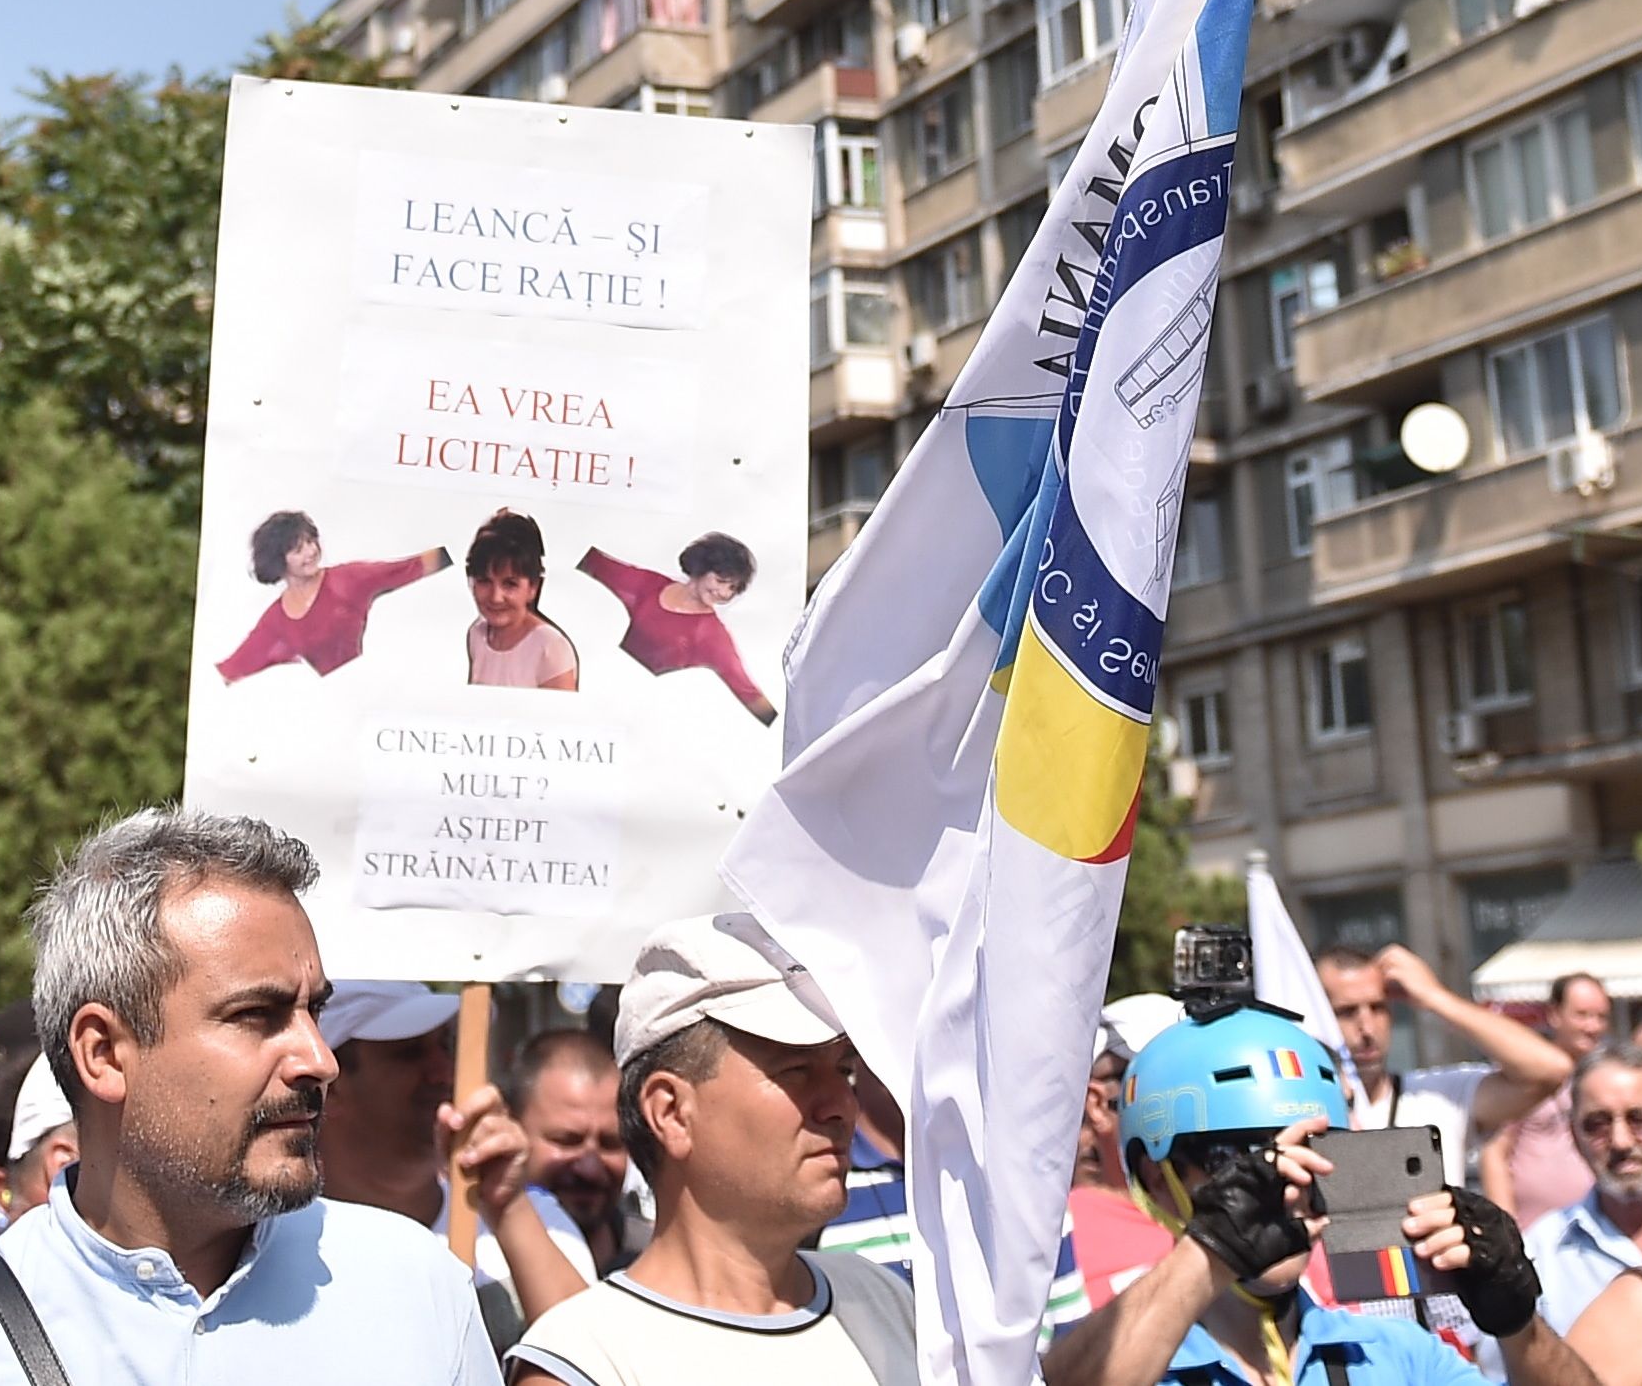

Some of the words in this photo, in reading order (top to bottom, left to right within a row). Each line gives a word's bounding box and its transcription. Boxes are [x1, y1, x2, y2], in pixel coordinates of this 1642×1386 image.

[403, 199, 578, 246] LEANCĂ
[626, 221, 661, 261] ȘI
[392, 254, 503, 295] FACE
[518, 265, 643, 310] RAȚIE
[426, 379, 482, 416] EA
[499, 387, 615, 429] VREA
[394, 433, 611, 491] LICITAȚIE
[376, 728, 495, 757] CINE-MI
[506, 731, 546, 761] DĂ
[558, 740, 615, 765] MAI
[440, 772, 528, 800] MULT
[537, 777, 549, 801] ?
[434, 816, 548, 846] AȘTEPT
[363, 851, 609, 887] STRĂINĂTATEA!
